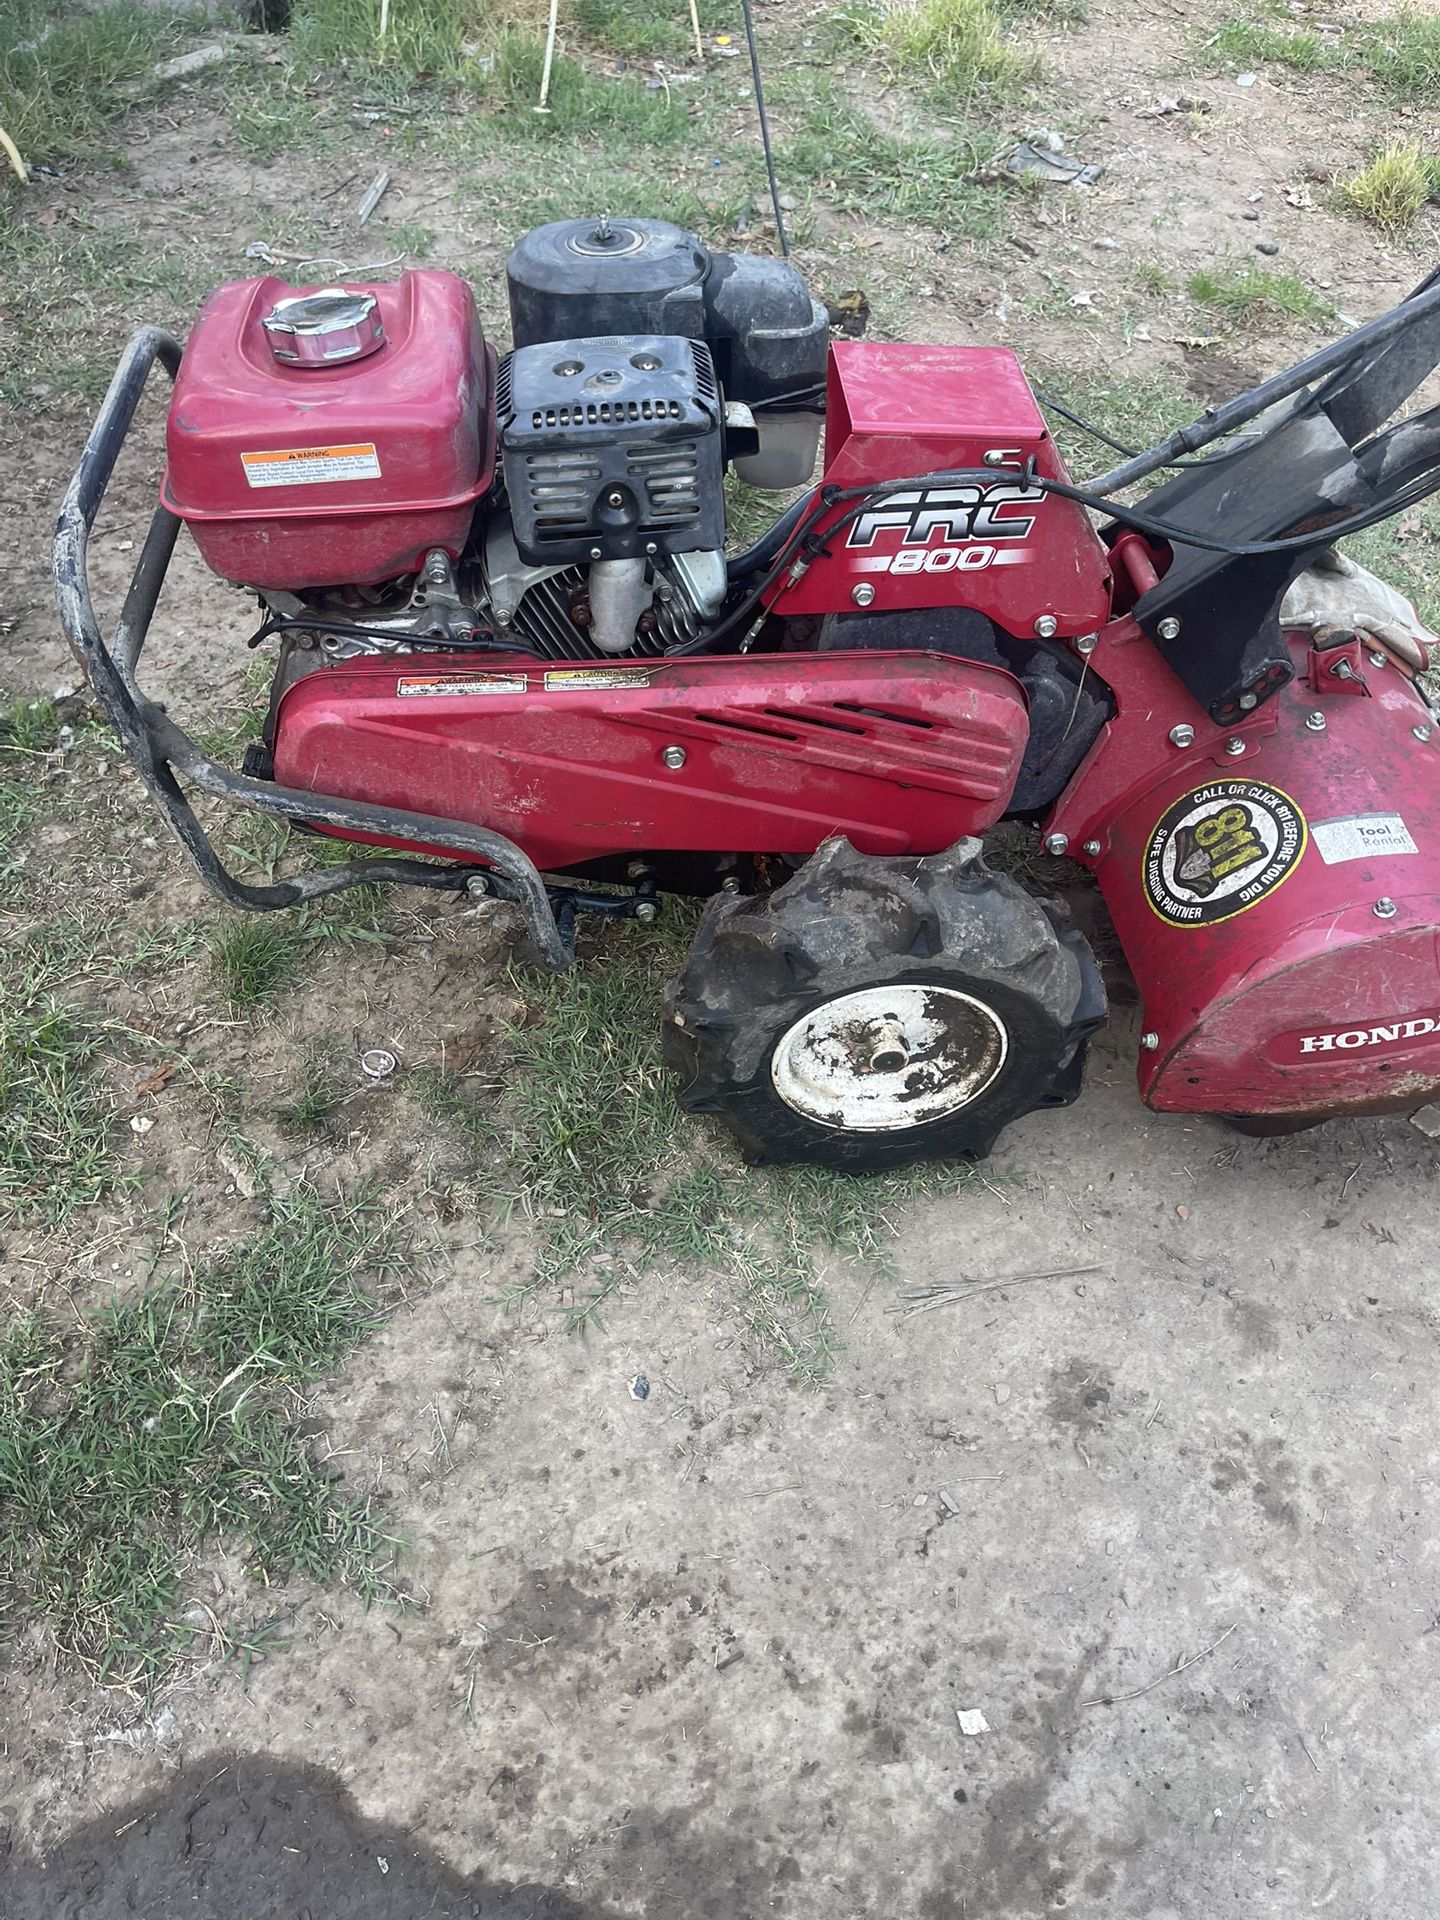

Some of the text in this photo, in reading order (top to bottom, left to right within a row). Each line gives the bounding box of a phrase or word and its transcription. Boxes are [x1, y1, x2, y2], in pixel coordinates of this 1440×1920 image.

[297, 451, 329, 459] WARNING
[845, 483, 1048, 548] FRC
[889, 546, 996, 575] 800
[1193, 784, 1298, 902] CALL OR CLICK 811 BEFORE YOU DIG
[1195, 807, 1263, 879] 811
[1357, 825, 1392, 836] Tool
[1362, 836, 1407, 848] Rental
[1149, 828, 1203, 919] SAFE DIGGING PARTNER
[1300, 1016, 1440, 1053] HOND
